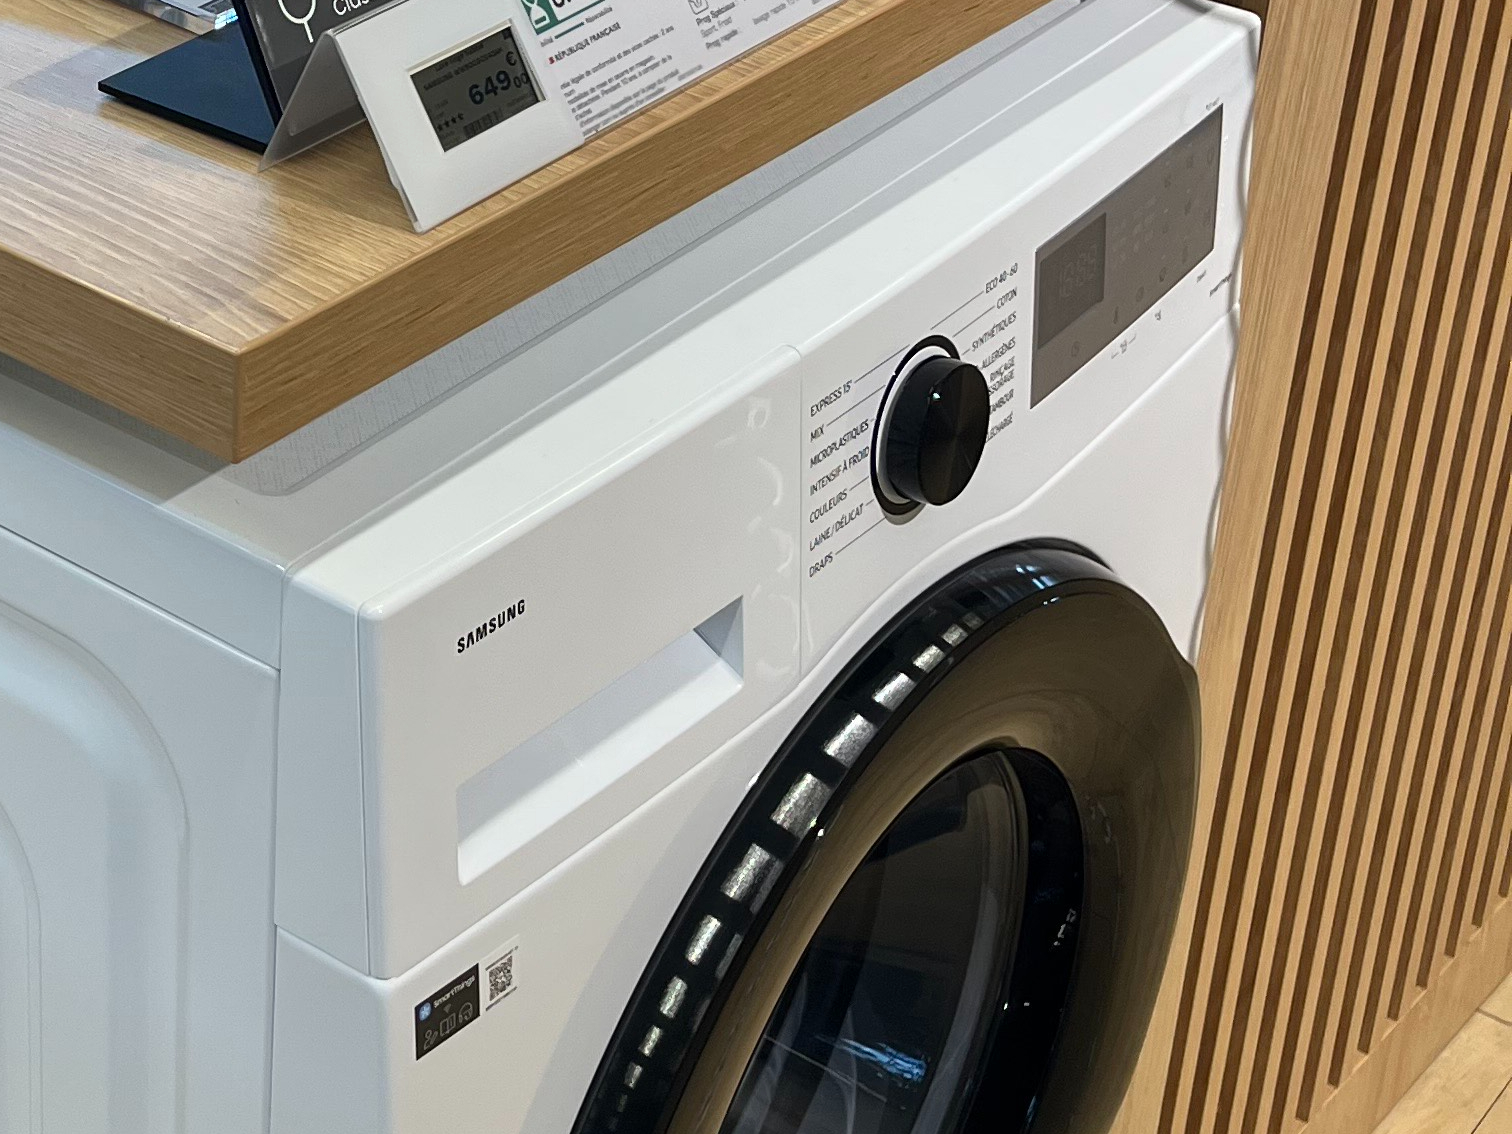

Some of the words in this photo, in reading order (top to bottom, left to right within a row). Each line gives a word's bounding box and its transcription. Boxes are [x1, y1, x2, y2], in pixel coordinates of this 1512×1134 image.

[468, 69, 512, 105] 649
[985, 276, 999, 294] ECO
[996, 286, 1018, 310] COTON
[971, 310, 1018, 352] SYNTHÉTIQUES
[810, 386, 842, 418] EXPRESS
[810, 423, 824, 444] MIX
[810, 418, 869, 469] MICROPLASTIQUES
[810, 464, 842, 497] INTENSIF
[848, 445, 870, 469] FROID
[809, 487, 848, 524] COULEURS
[808, 551, 834, 578] DRAPS
[456, 598, 527, 655] SAMSUNG
